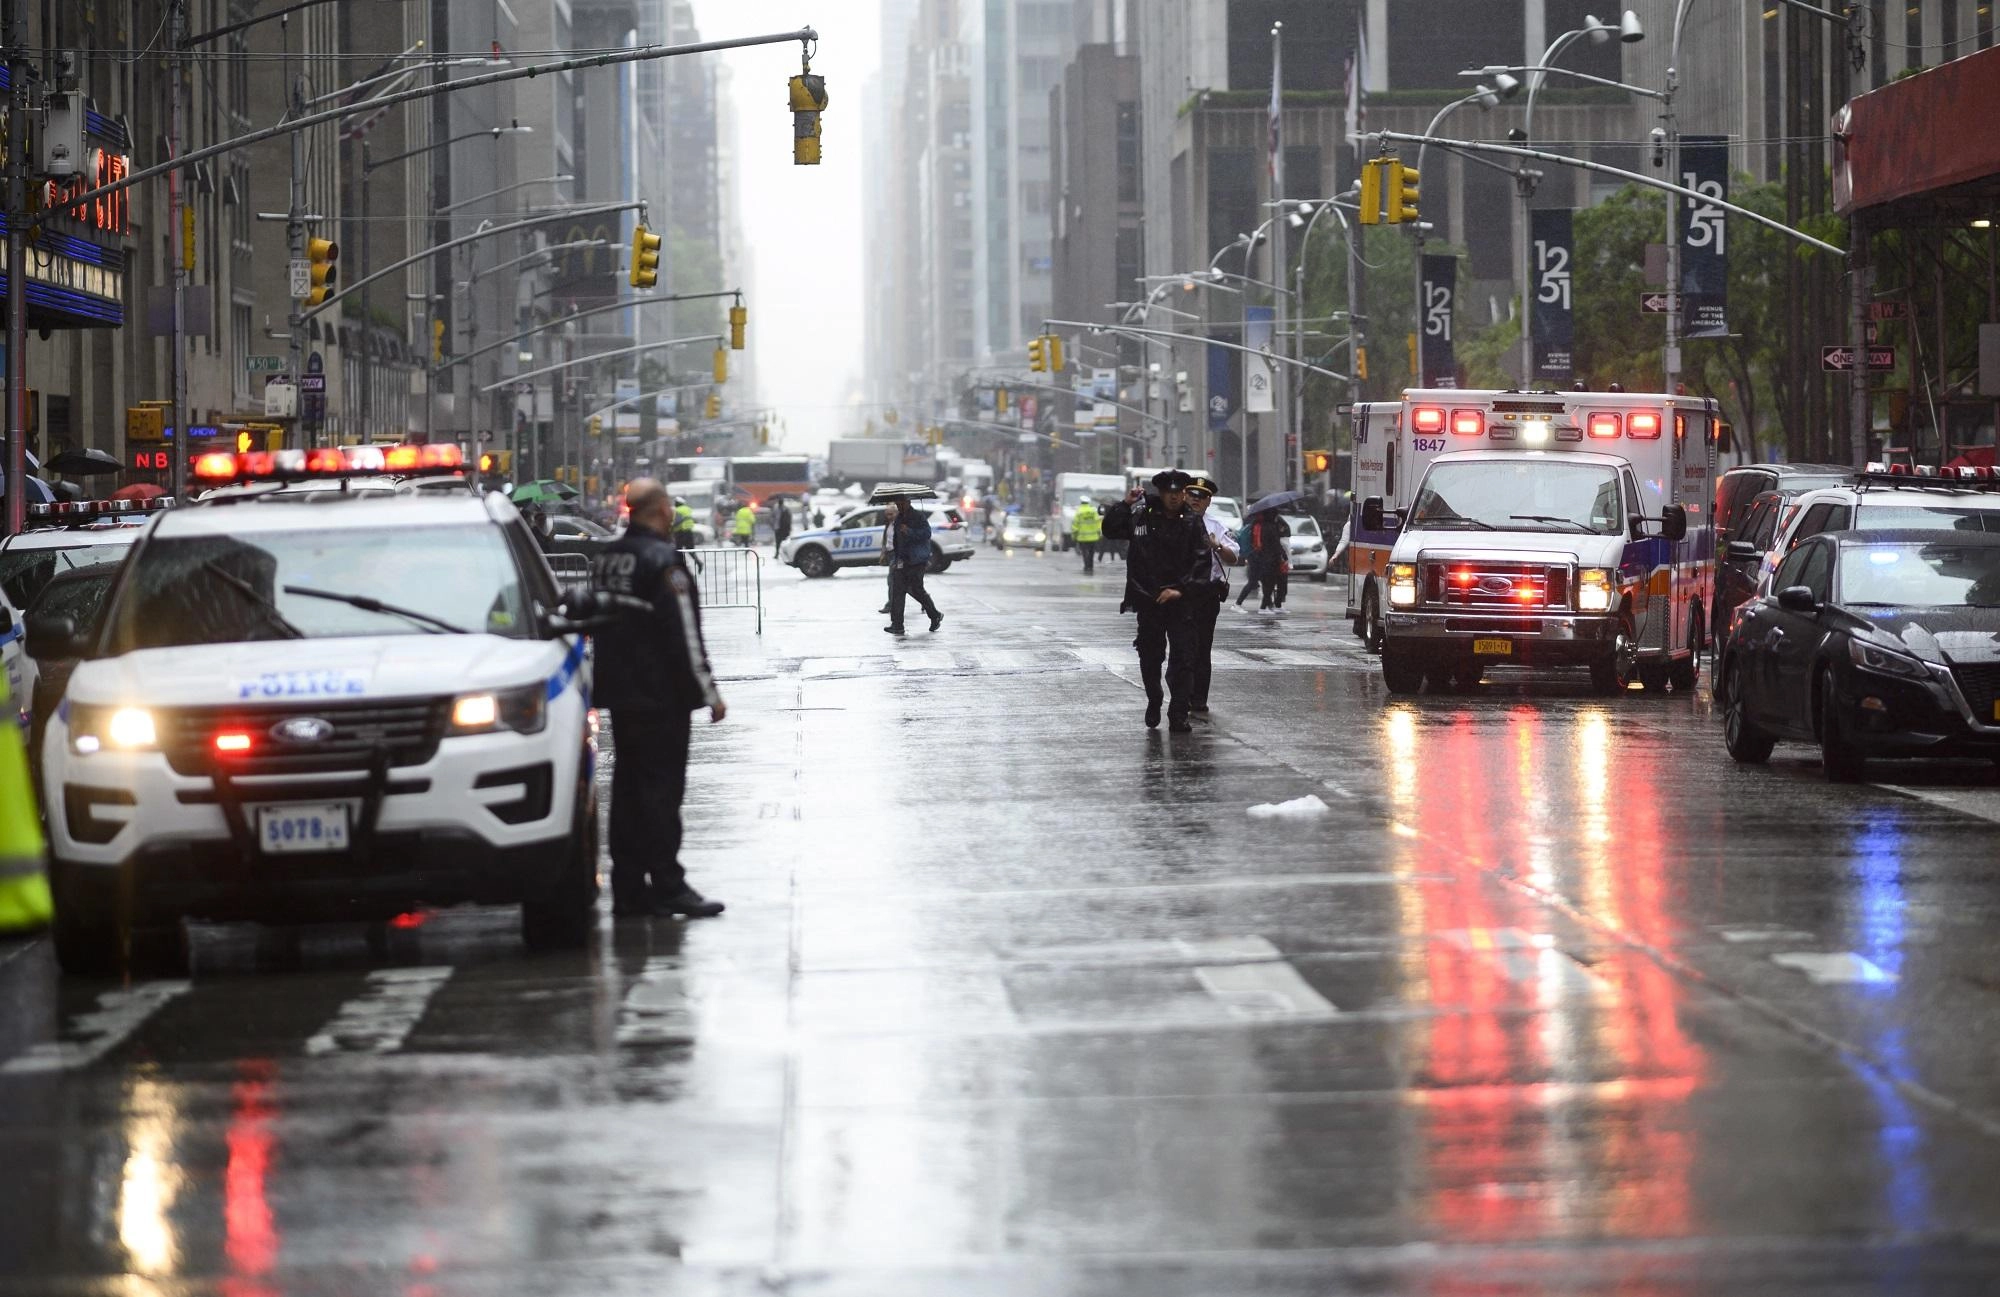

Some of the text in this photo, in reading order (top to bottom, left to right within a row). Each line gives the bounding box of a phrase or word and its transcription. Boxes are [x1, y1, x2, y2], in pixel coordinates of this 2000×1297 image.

[90, 148, 130, 237] CITY
[1683, 172, 1725, 217] 12
[1686, 210, 1725, 255] 51
[1534, 240, 1570, 278] 12
[1424, 281, 1451, 313] 12
[1538, 271, 1571, 310] 51
[1425, 308, 1451, 341] 51
[248, 359, 256, 369] W
[258, 358, 268, 369] 50
[1832, 354, 1854, 364] ONE
[188, 427, 218, 436] SHOW
[1412, 439, 1446, 452] 1847
[842, 535, 873, 549] NYPD
[268, 817, 323, 842] 5078
